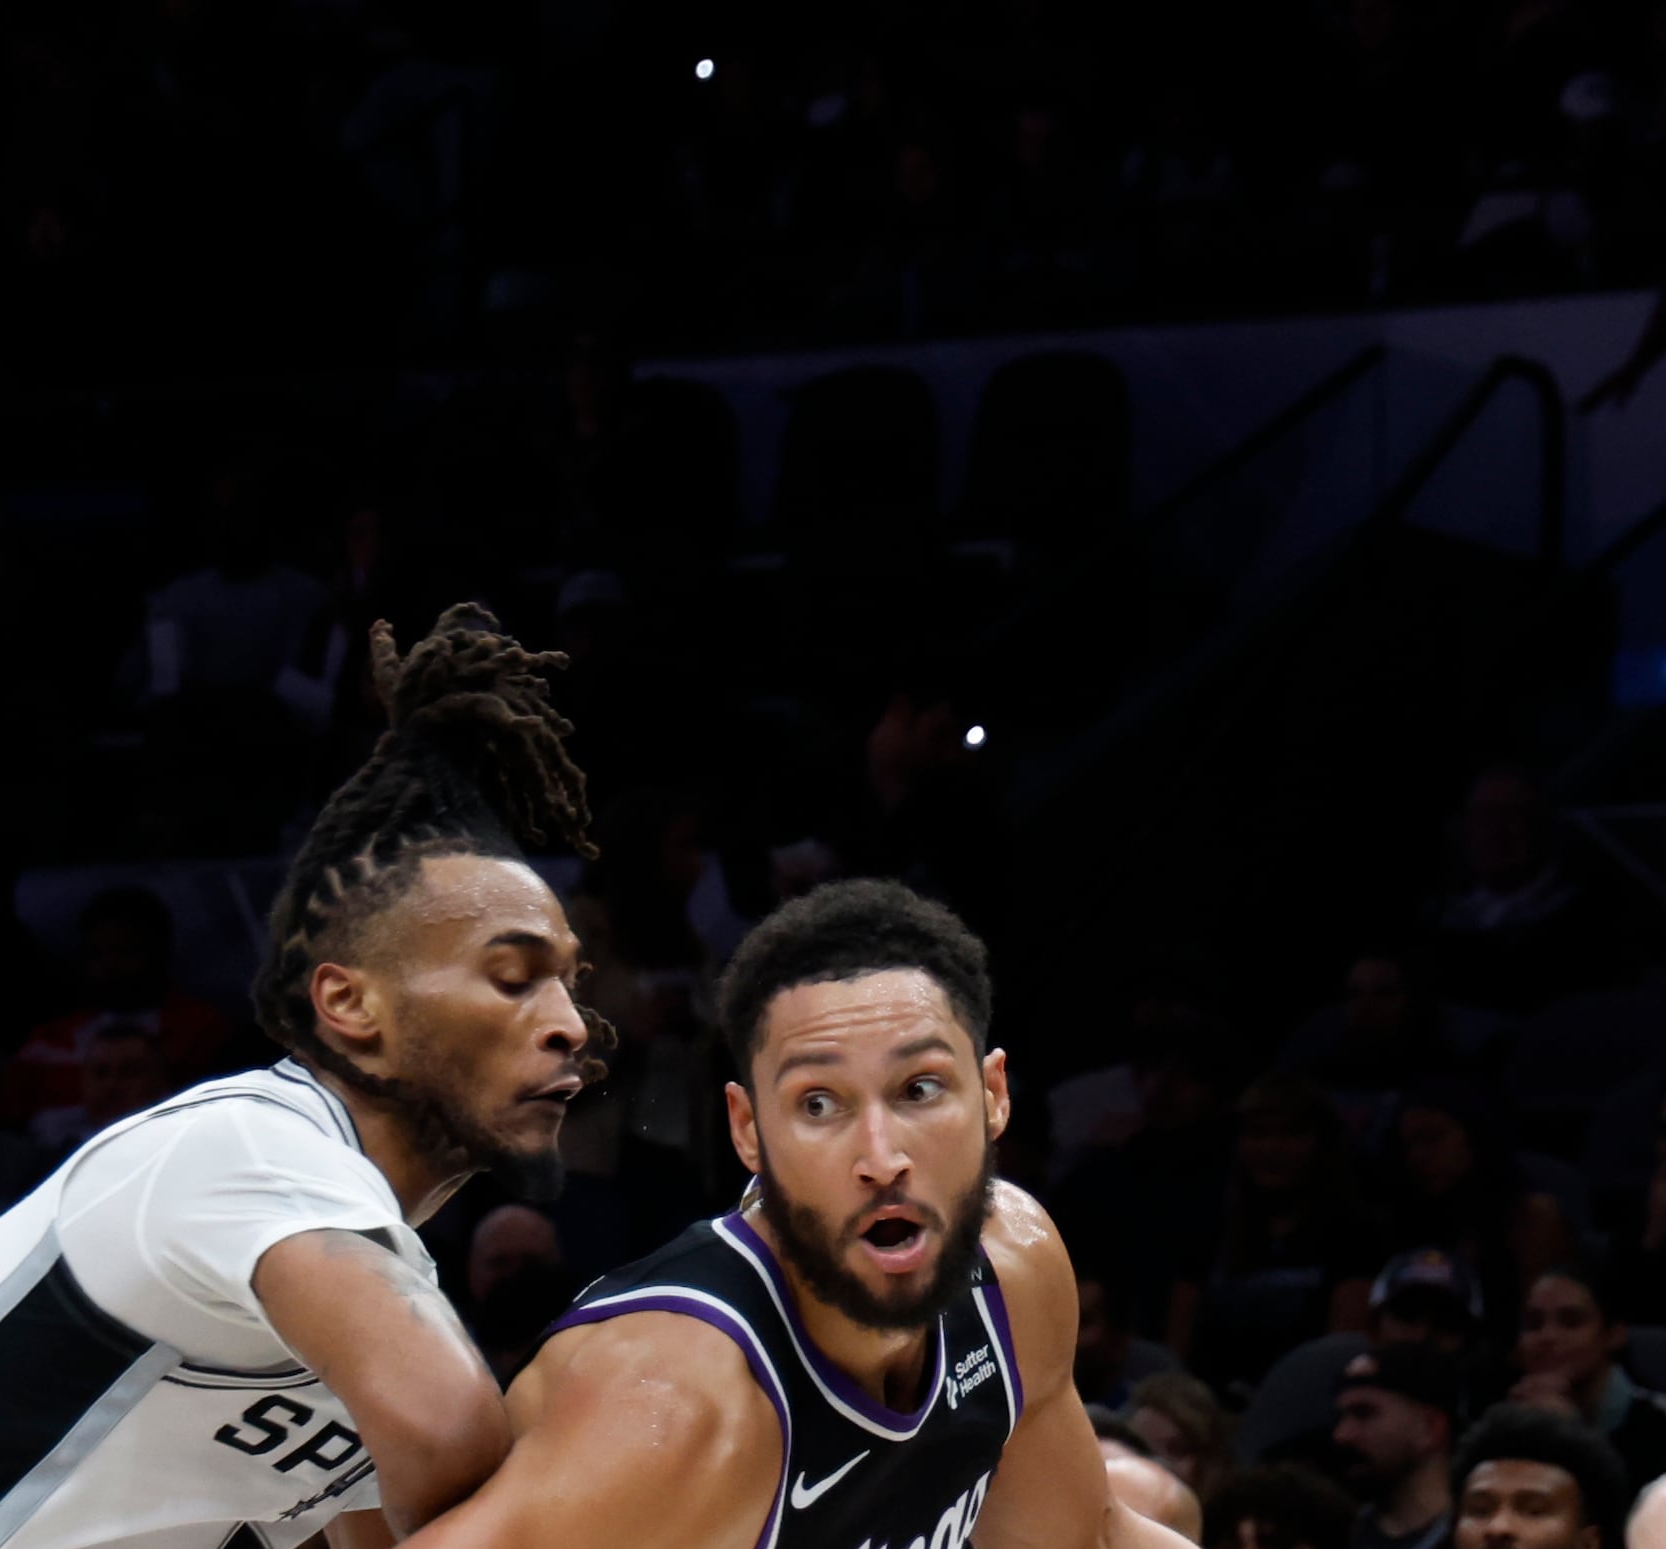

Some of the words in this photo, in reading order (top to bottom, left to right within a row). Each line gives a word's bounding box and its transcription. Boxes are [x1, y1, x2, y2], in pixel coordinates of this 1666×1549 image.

[955, 1343, 989, 1380] Sutter
[959, 1360, 997, 1398] Health
[213, 1393, 363, 1473] SP
